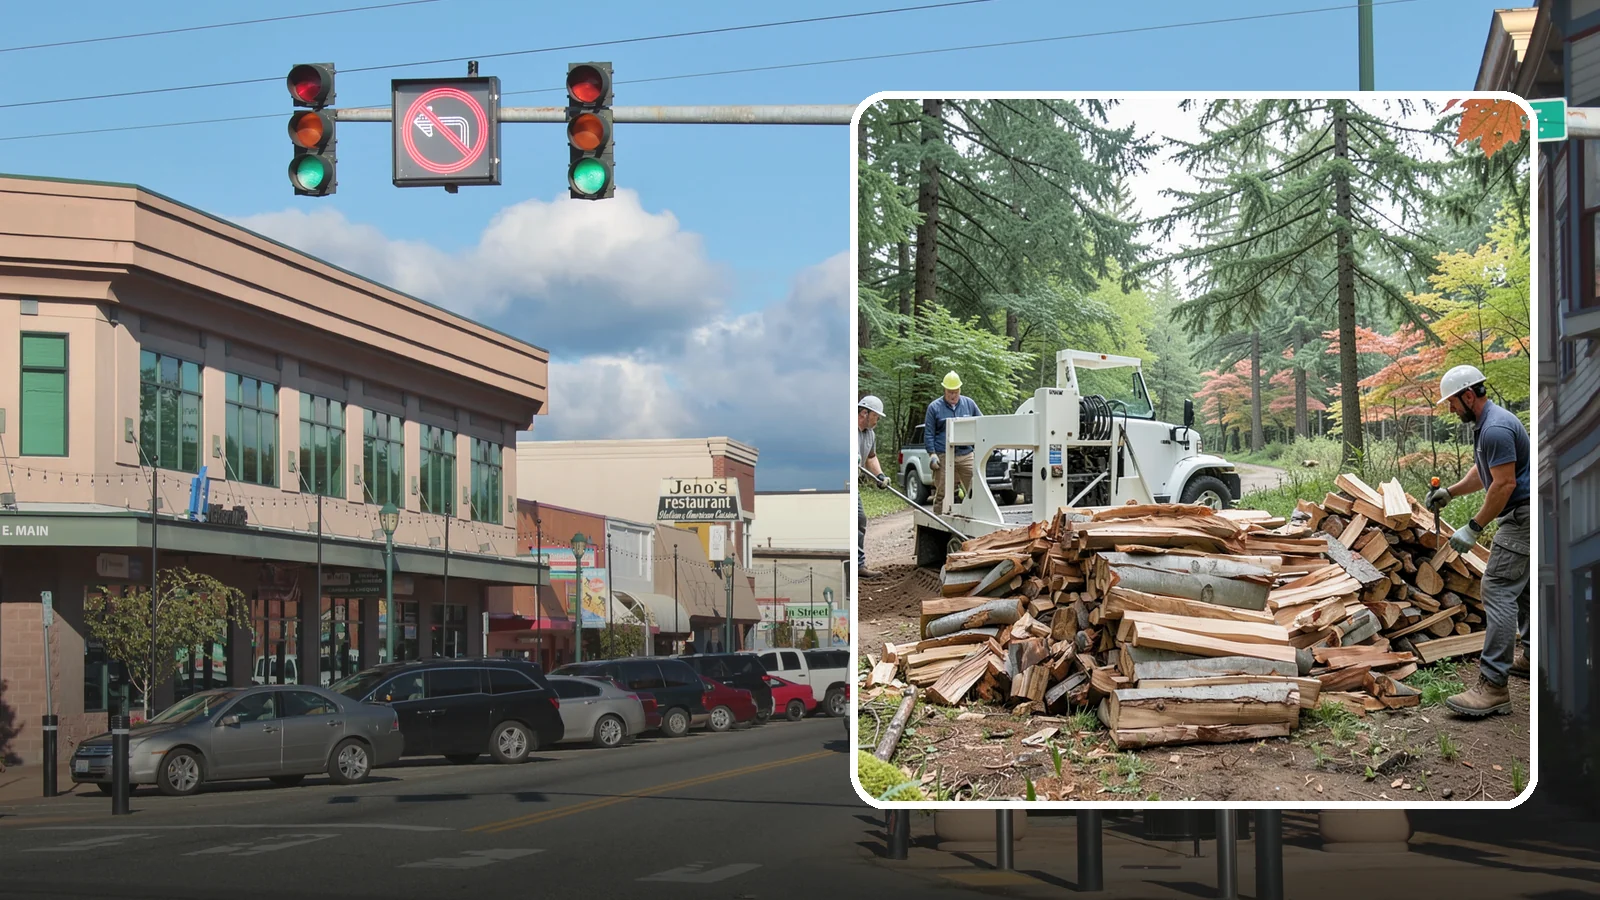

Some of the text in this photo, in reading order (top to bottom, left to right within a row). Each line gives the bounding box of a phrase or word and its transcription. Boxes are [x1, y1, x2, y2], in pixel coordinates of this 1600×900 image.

[670, 480, 727, 494] Jeno's
[665, 496, 731, 509] restaurant
[658, 509, 681, 519] Italian
[686, 509, 715, 519] American
[715, 509, 738, 519] Cuisine
[2, 525, 49, 536] E. MAIN
[797, 607, 828, 617] Street
